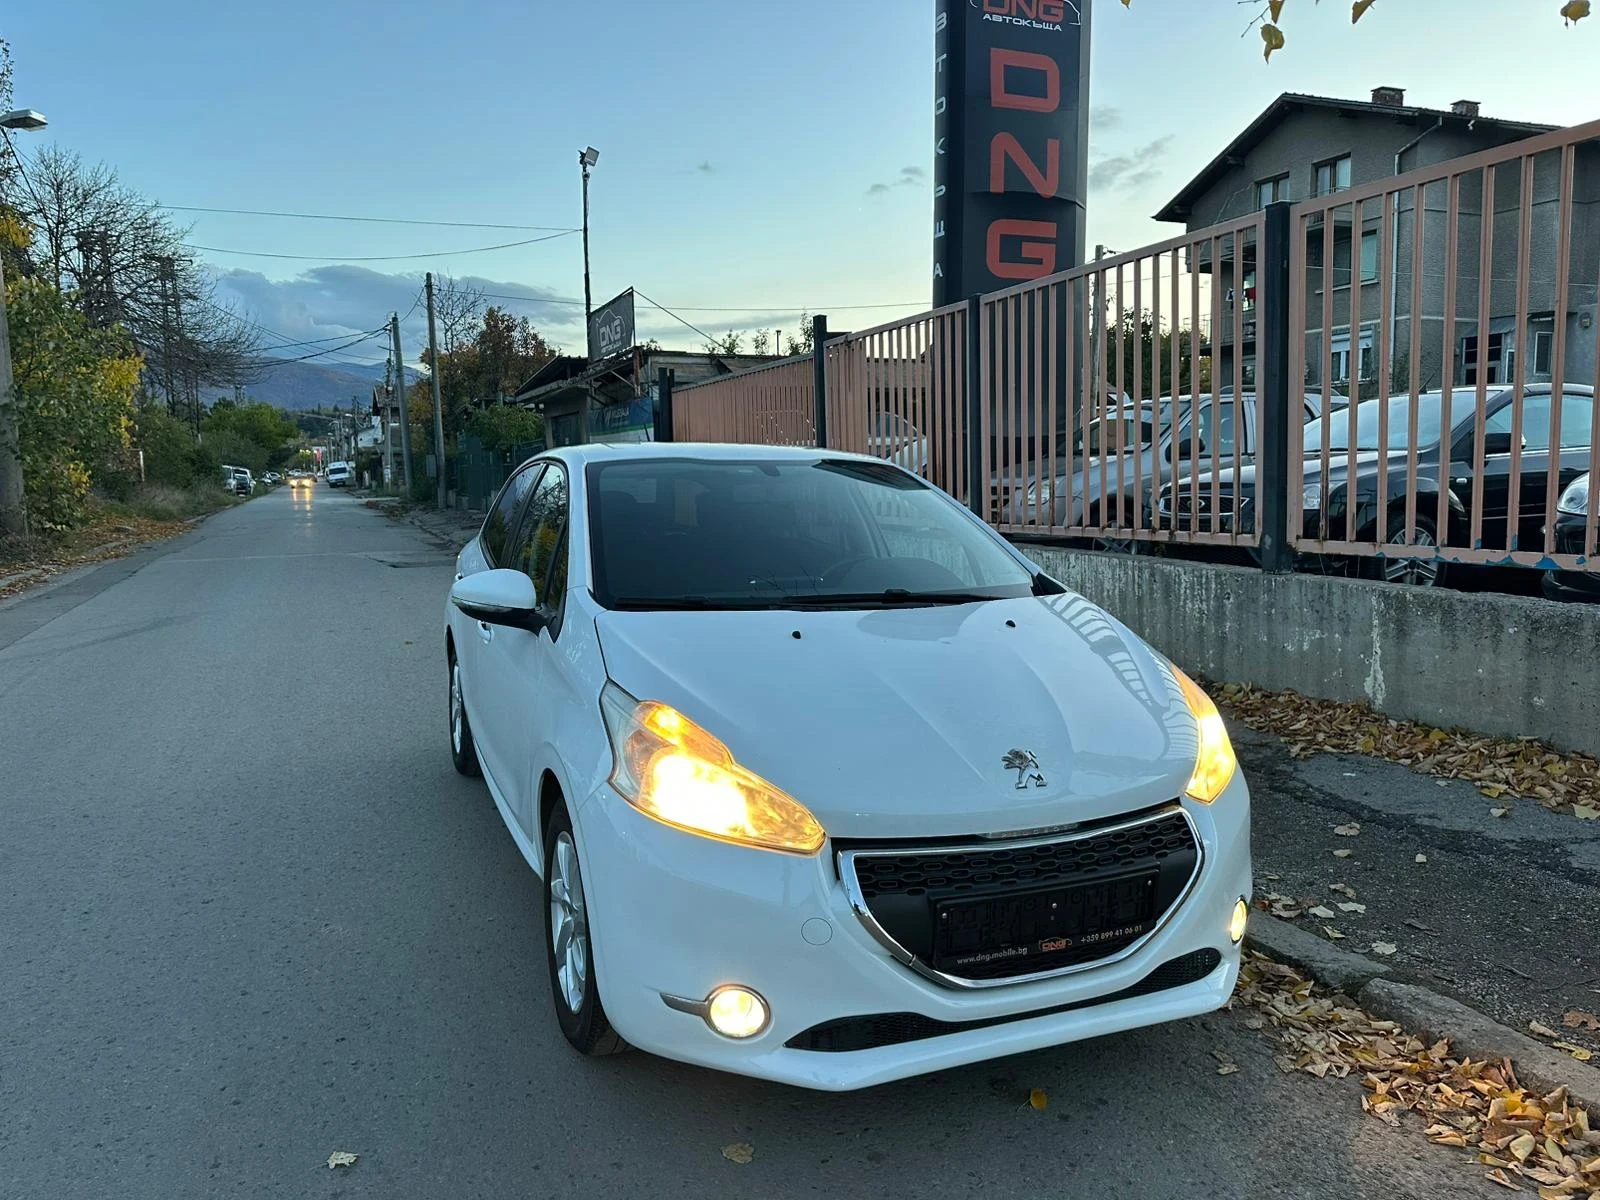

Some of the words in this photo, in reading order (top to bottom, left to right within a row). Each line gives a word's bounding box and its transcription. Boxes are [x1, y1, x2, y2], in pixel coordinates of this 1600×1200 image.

[982, 13, 1062, 32] АВТОКЪЩА
[600, 318, 621, 347] DNG
[956, 946, 1028, 964] www.dng.mobile.bg
[1080, 933, 1099, 943] +359
[1100, 930, 1114, 940] 899
[1114, 928, 1123, 936] 41
[1124, 926, 1133, 935] 06
[1134, 924, 1142, 932] 01
